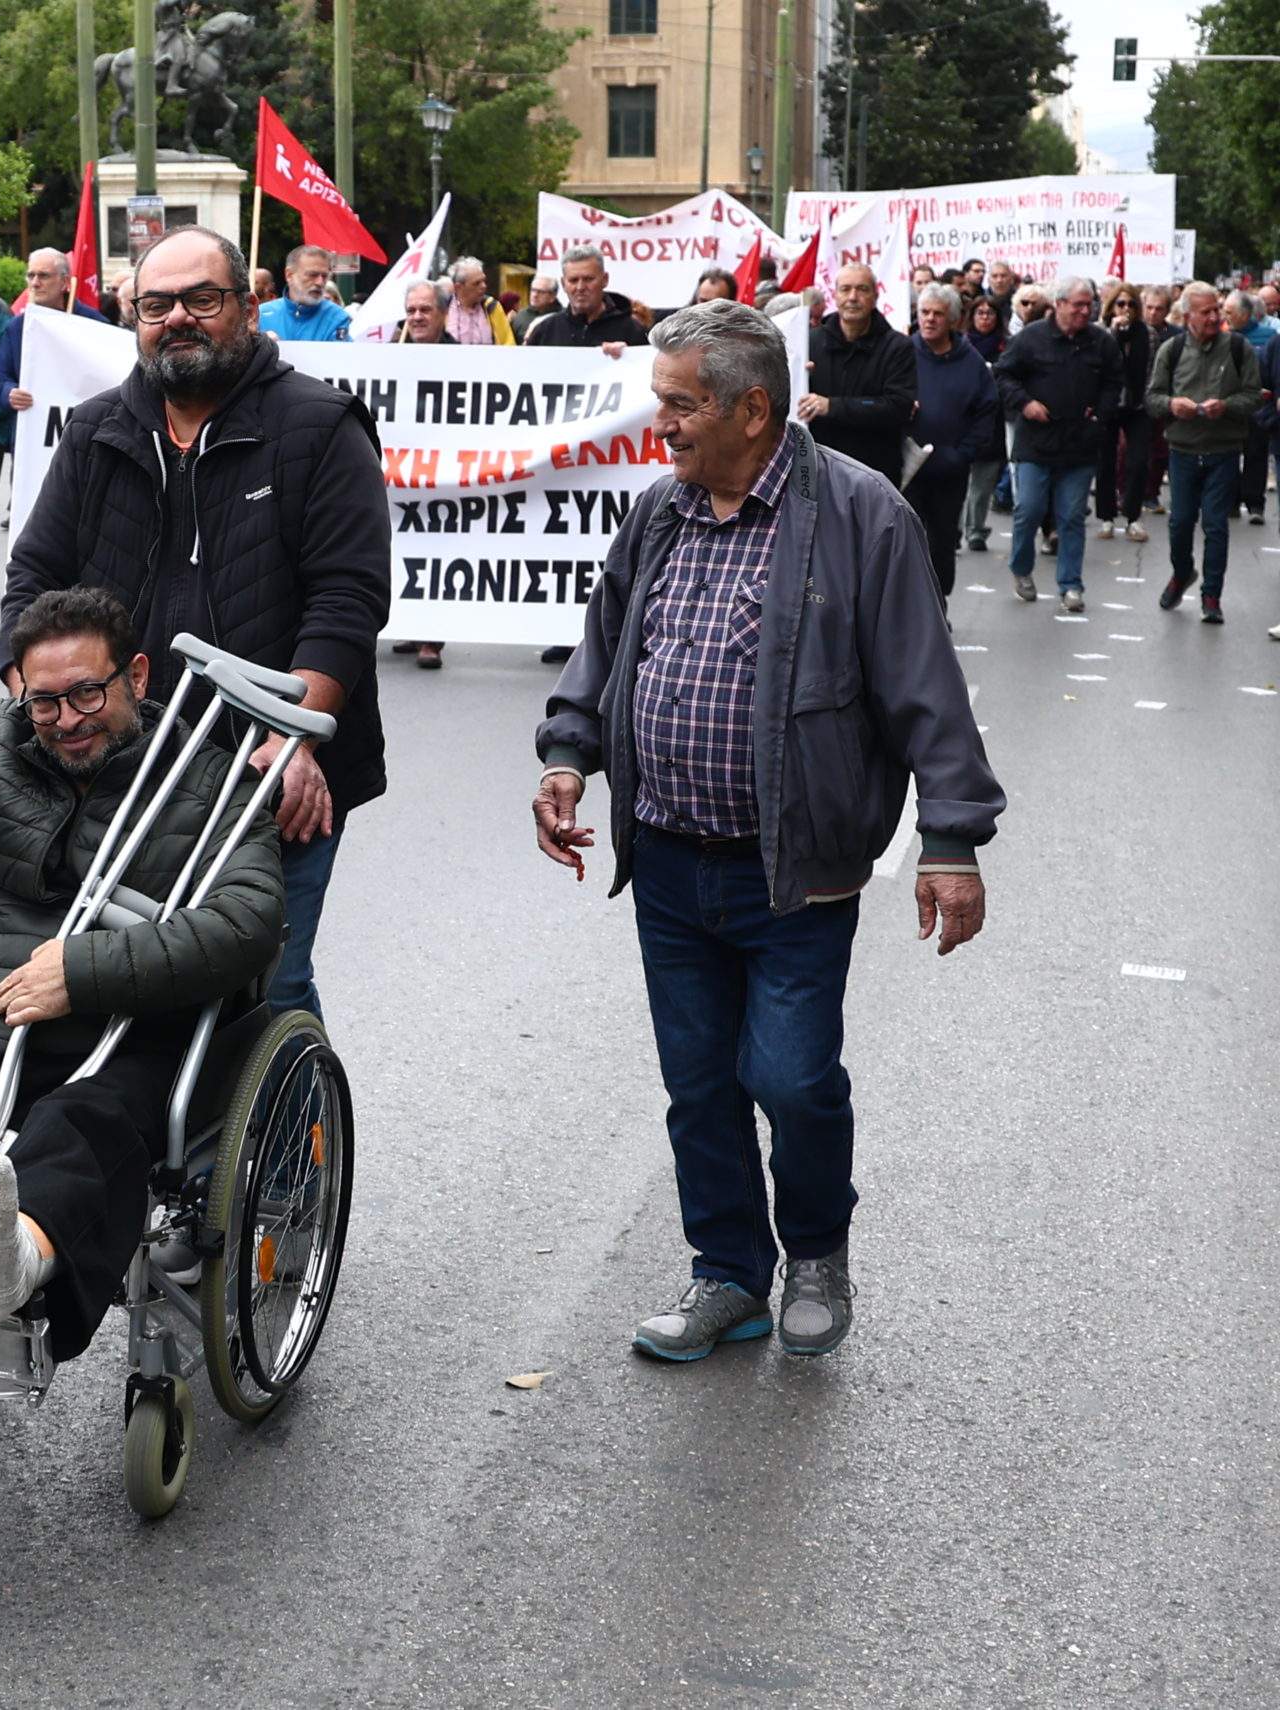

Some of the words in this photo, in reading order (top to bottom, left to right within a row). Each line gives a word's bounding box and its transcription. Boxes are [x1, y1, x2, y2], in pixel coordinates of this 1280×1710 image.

[416, 380, 622, 425] ΠΕΙΡΑΤΕΙΑ
[457, 450, 535, 487] ΤΗΣ
[550, 427, 672, 470] ΕΛΛΑ
[394, 490, 526, 534] ΧΩΡΙΣ
[543, 489, 630, 534] ΣΥΝ
